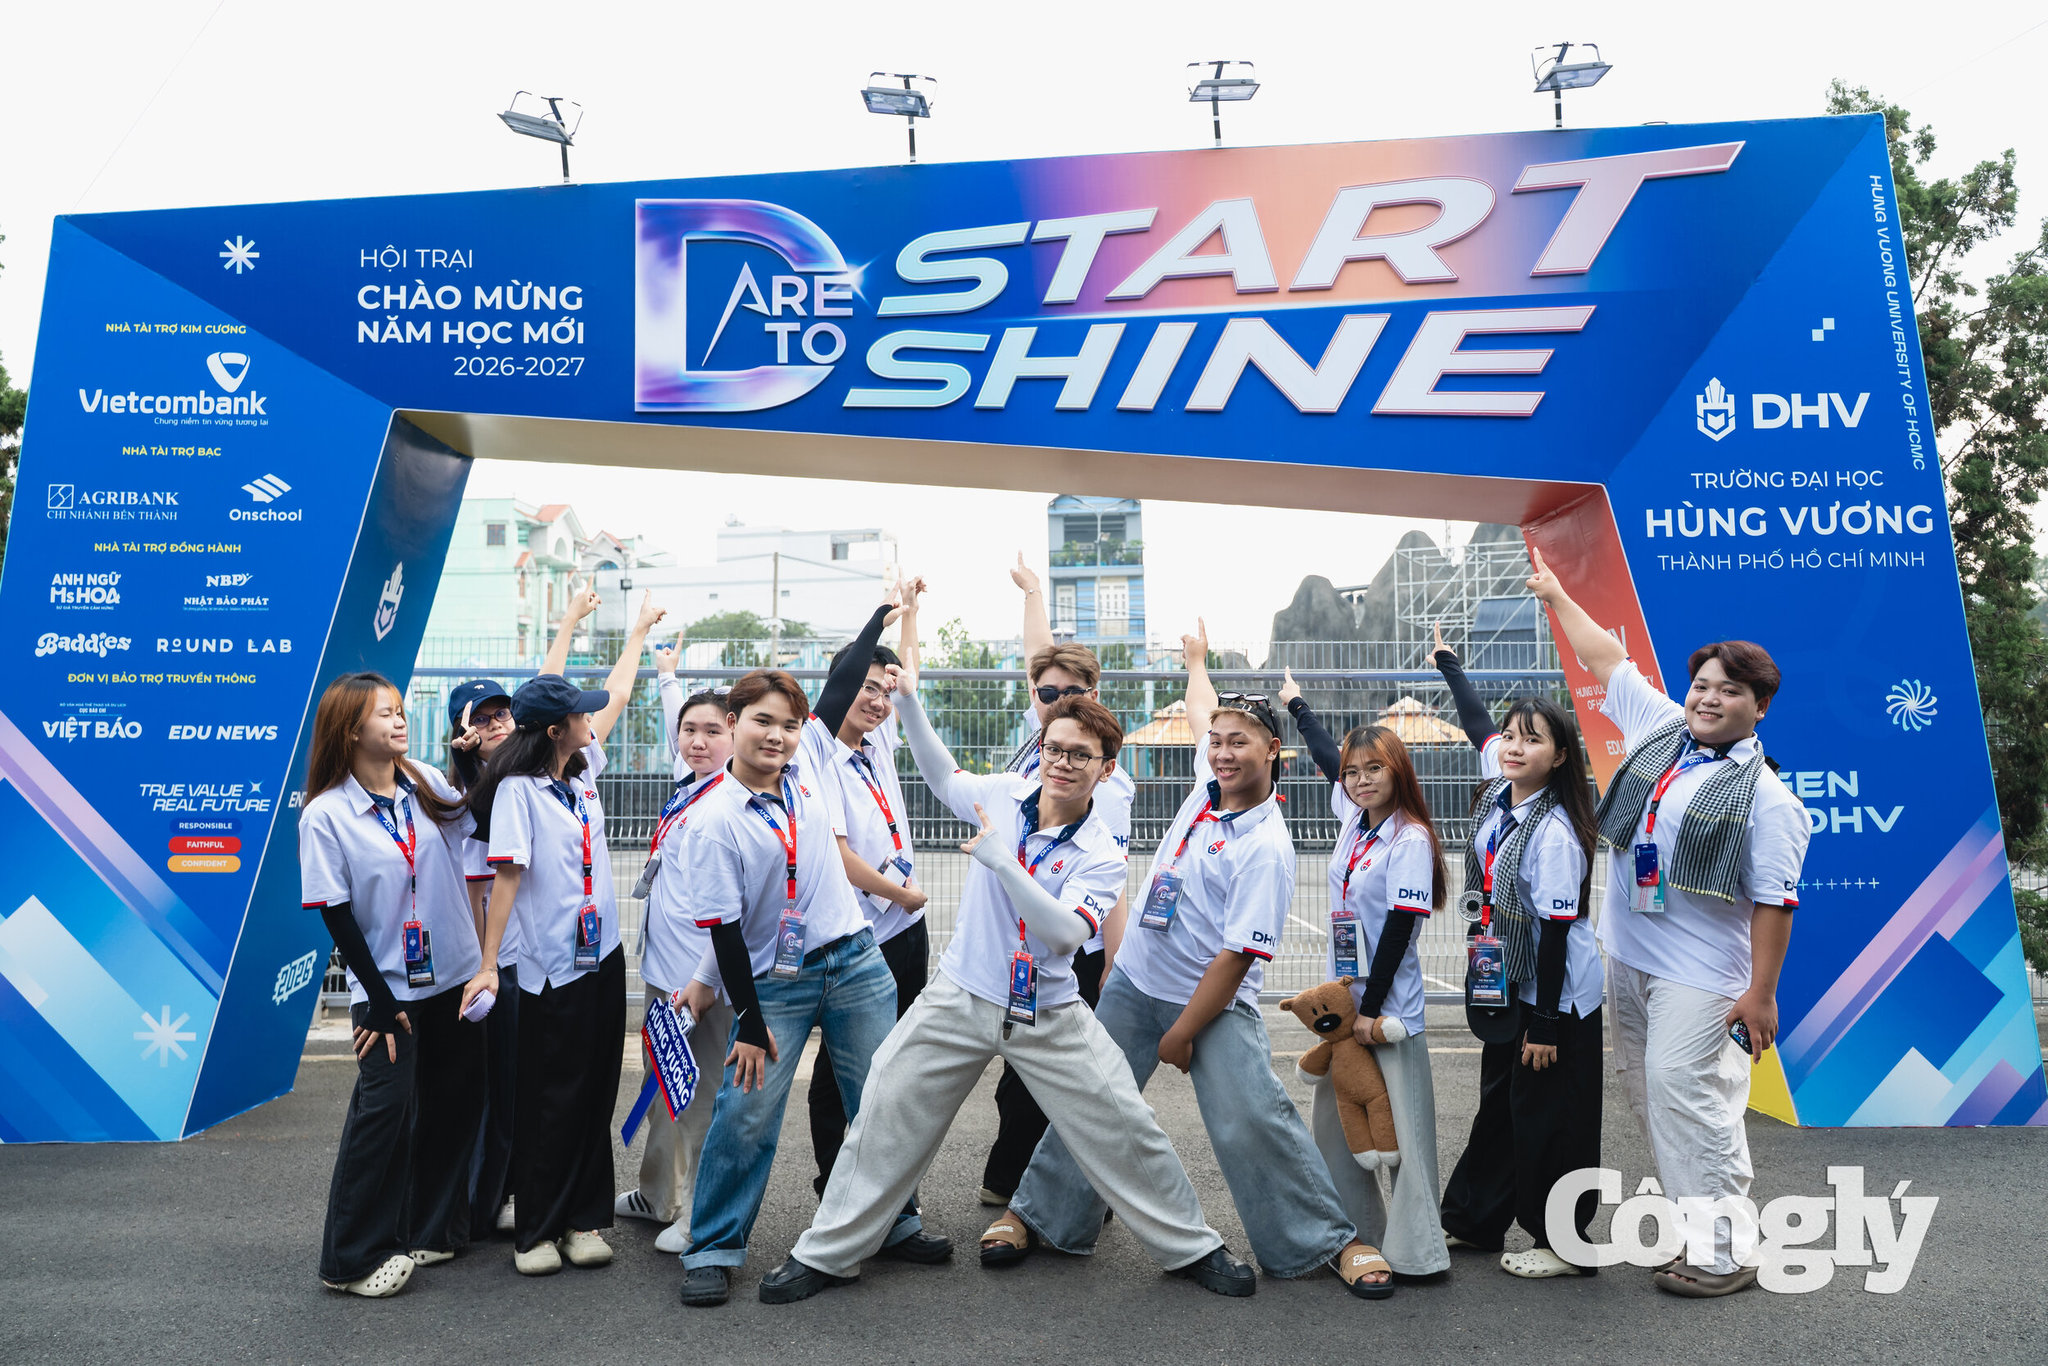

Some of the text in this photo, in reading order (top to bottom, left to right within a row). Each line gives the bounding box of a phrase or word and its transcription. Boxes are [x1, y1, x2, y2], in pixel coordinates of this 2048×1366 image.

[876, 141, 1745, 318] START
[360, 244, 473, 273] HỘI TRẠI
[357, 279, 583, 311] CHÀO MỪNG
[105, 322, 247, 335] NHÀ TÀI TRỢ KIM CƯƠNG
[1869, 175, 1926, 471] HUNG VUONG UNIVERSITY OF HCMC
[357, 315, 584, 350] NĂM HỌC MỚI
[764, 322, 847, 366] TO
[454, 356, 585, 376] 2026-2027
[843, 306, 1597, 417] SHINE
[79, 387, 267, 416] Vietcombank
[1751, 392, 1871, 429] DHV
[154, 417, 179, 426] Chung
[202, 417, 212, 426] tin
[259, 418, 269, 427] lai
[122, 445, 222, 458] NHÀ TÀI TRỢ BẠC
[1690, 468, 1884, 491] TRƯỜNG ĐẠI HỌC
[78, 491, 179, 506] AGRIBANK
[46, 510, 67, 520] CHI
[69, 509, 110, 520] NHÁNH
[138, 509, 178, 521] THÀNH
[229, 508, 302, 522] Onschool
[1645, 500, 1934, 538] HÙNG VƯƠNG
[94, 541, 242, 554] NHÀ TÀI TRỢ ĐỒNG HÀNH
[1657, 548, 1925, 571] THÀNH PHỐ HỒ CHÍ MINH
[52, 571, 122, 586] ANH NGỮ
[184, 594, 270, 607] NHẬT BẢO PHÁT
[34, 632, 132, 658] Baddies
[247, 638, 292, 653] LAB
[68, 671, 256, 684] ĐƠN VỊ BẢO TRỢ TRUYỀN THÔNG
[1575, 685, 1594, 698] HUNG
[42, 716, 143, 743] VIỆT BÁO
[168, 725, 279, 741] EDU NEWS
[139, 783, 244, 797] TRUE VALUE
[152, 798, 271, 812] REAL FUTURE
[179, 822, 233, 830] RESPONSIBLE
[186, 840, 225, 849] FAITHFUL
[181, 859, 228, 867] CONFIDENT
[1398, 887, 1429, 902] DHV
[1552, 898, 1577, 910] DH
